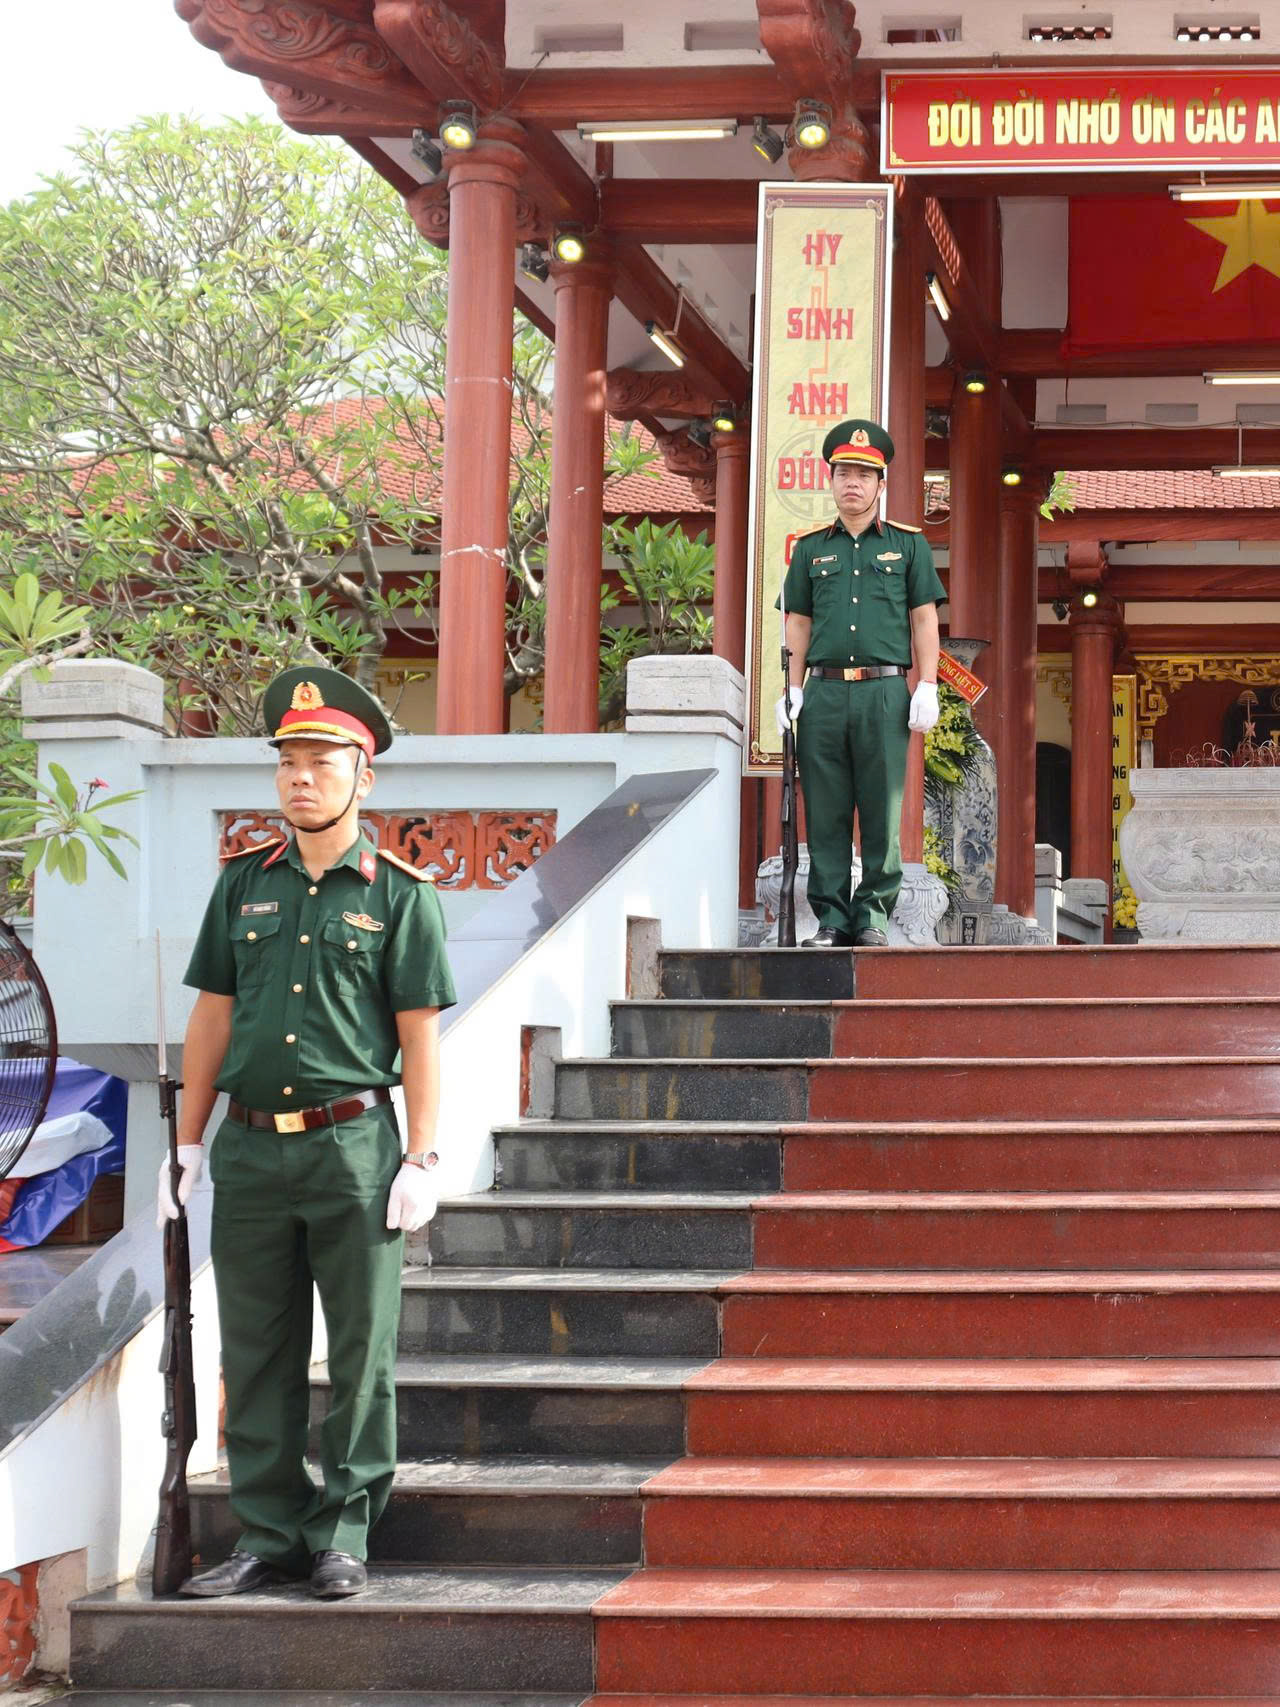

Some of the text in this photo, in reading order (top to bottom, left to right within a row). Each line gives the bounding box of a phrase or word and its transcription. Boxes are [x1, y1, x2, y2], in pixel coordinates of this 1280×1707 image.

[928, 88, 981, 147] ĐỜI
[992, 89, 1044, 146] ĐỜI
[1055, 88, 1121, 145] NHỚ
[1131, 93, 1176, 144] ƠN
[1185, 87, 1247, 144] CÁC
[802, 233, 844, 266] HY
[787, 307, 854, 340] SINH
[787, 382, 848, 415] ANH
[777, 449, 832, 490] DŨN
